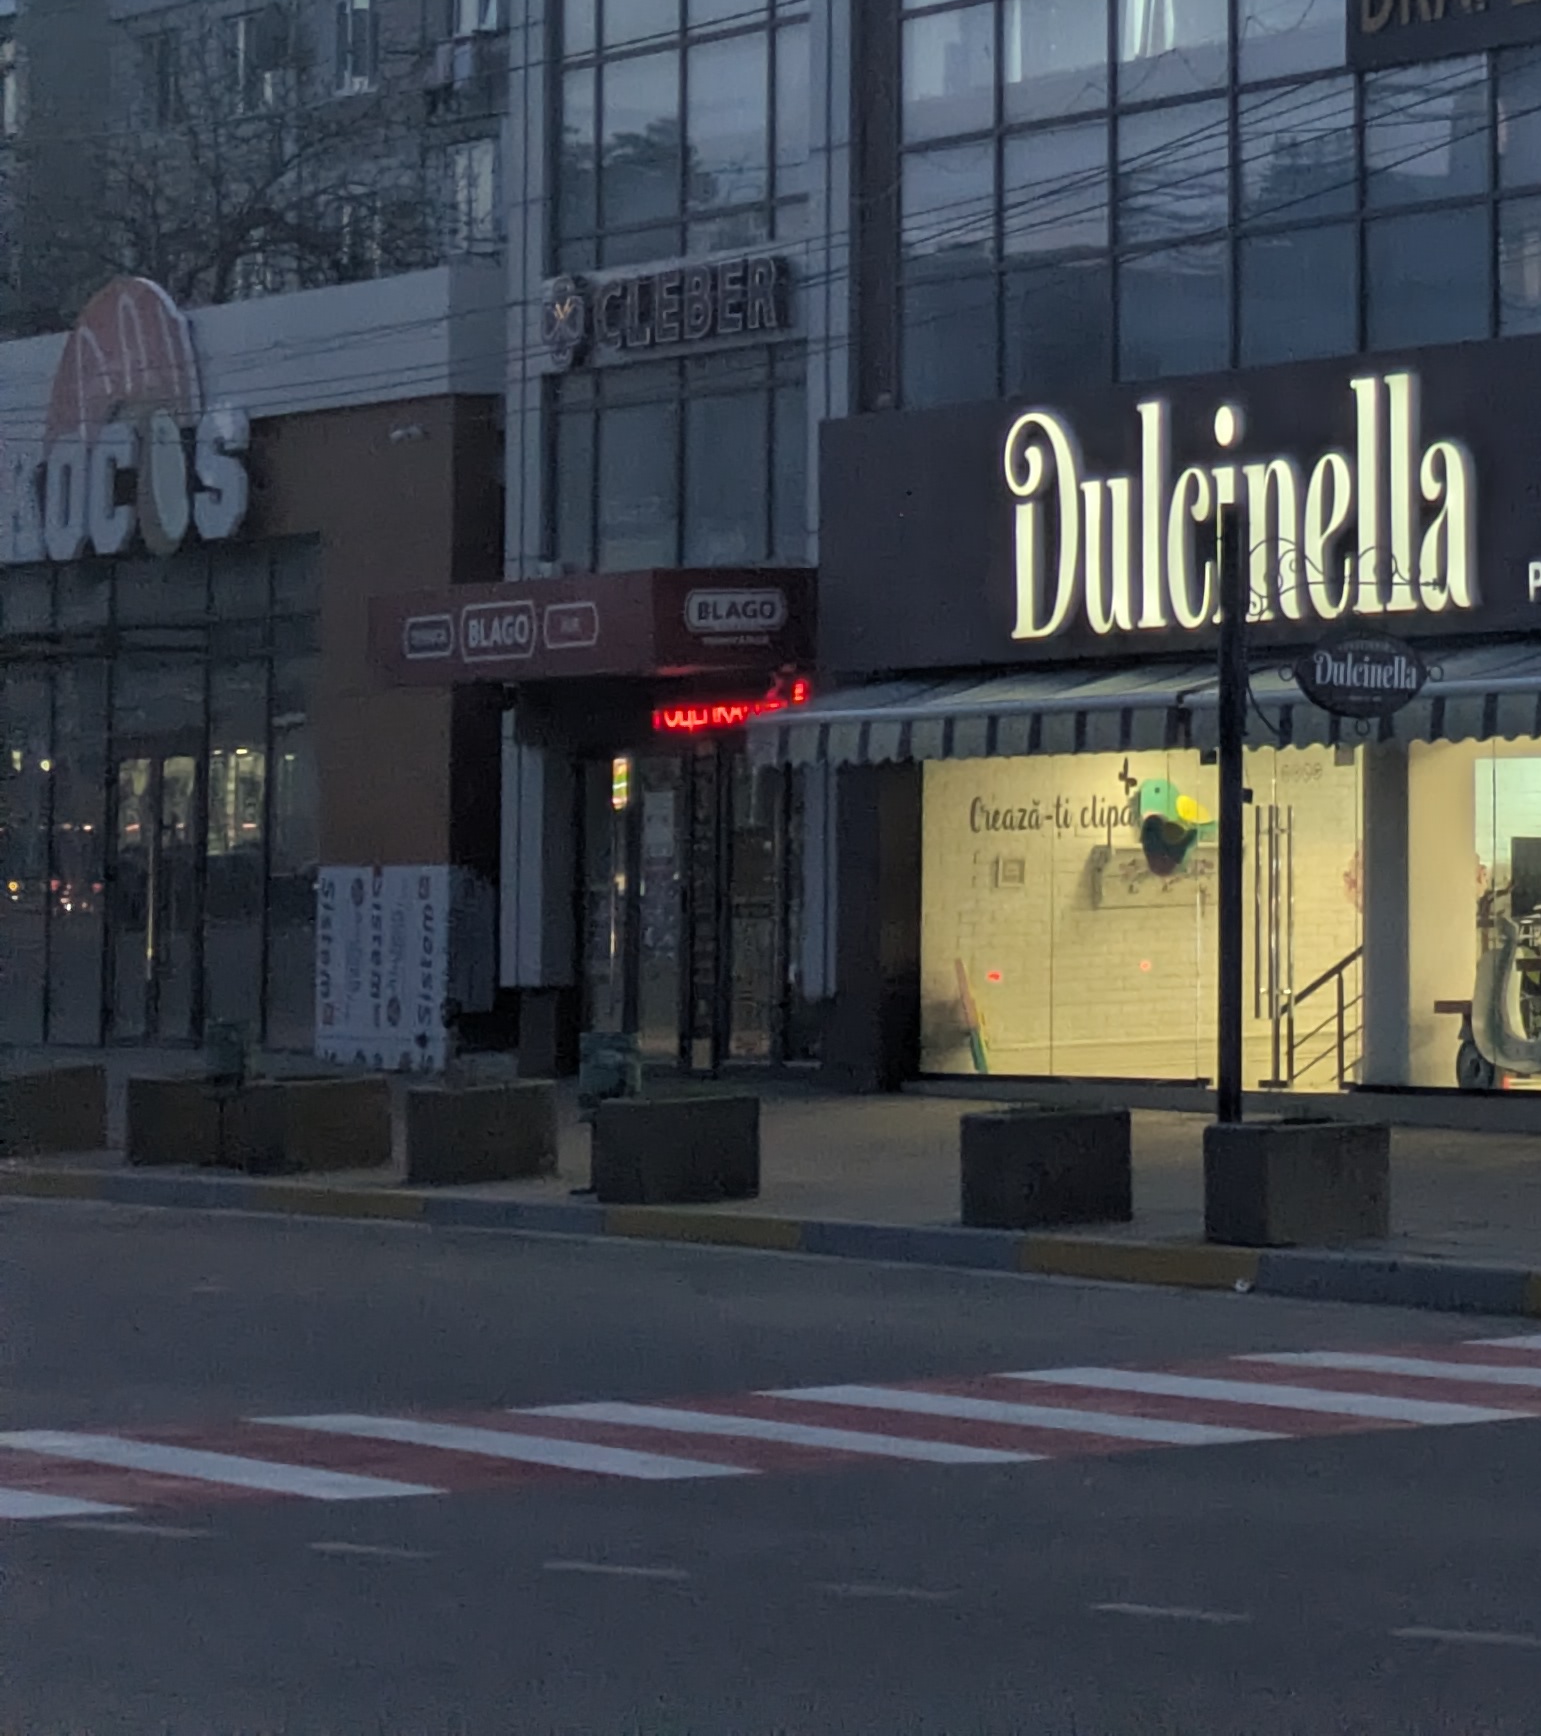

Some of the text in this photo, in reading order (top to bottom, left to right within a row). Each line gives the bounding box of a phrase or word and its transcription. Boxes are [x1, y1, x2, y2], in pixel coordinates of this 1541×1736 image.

[593, 257, 778, 349] CLEBER
[1004, 371, 1471, 640] Dulcinella
[697, 600, 776, 621] BLAGO
[468, 614, 530, 648] BLAGO
[1313, 649, 1417, 689] Dulcinella
